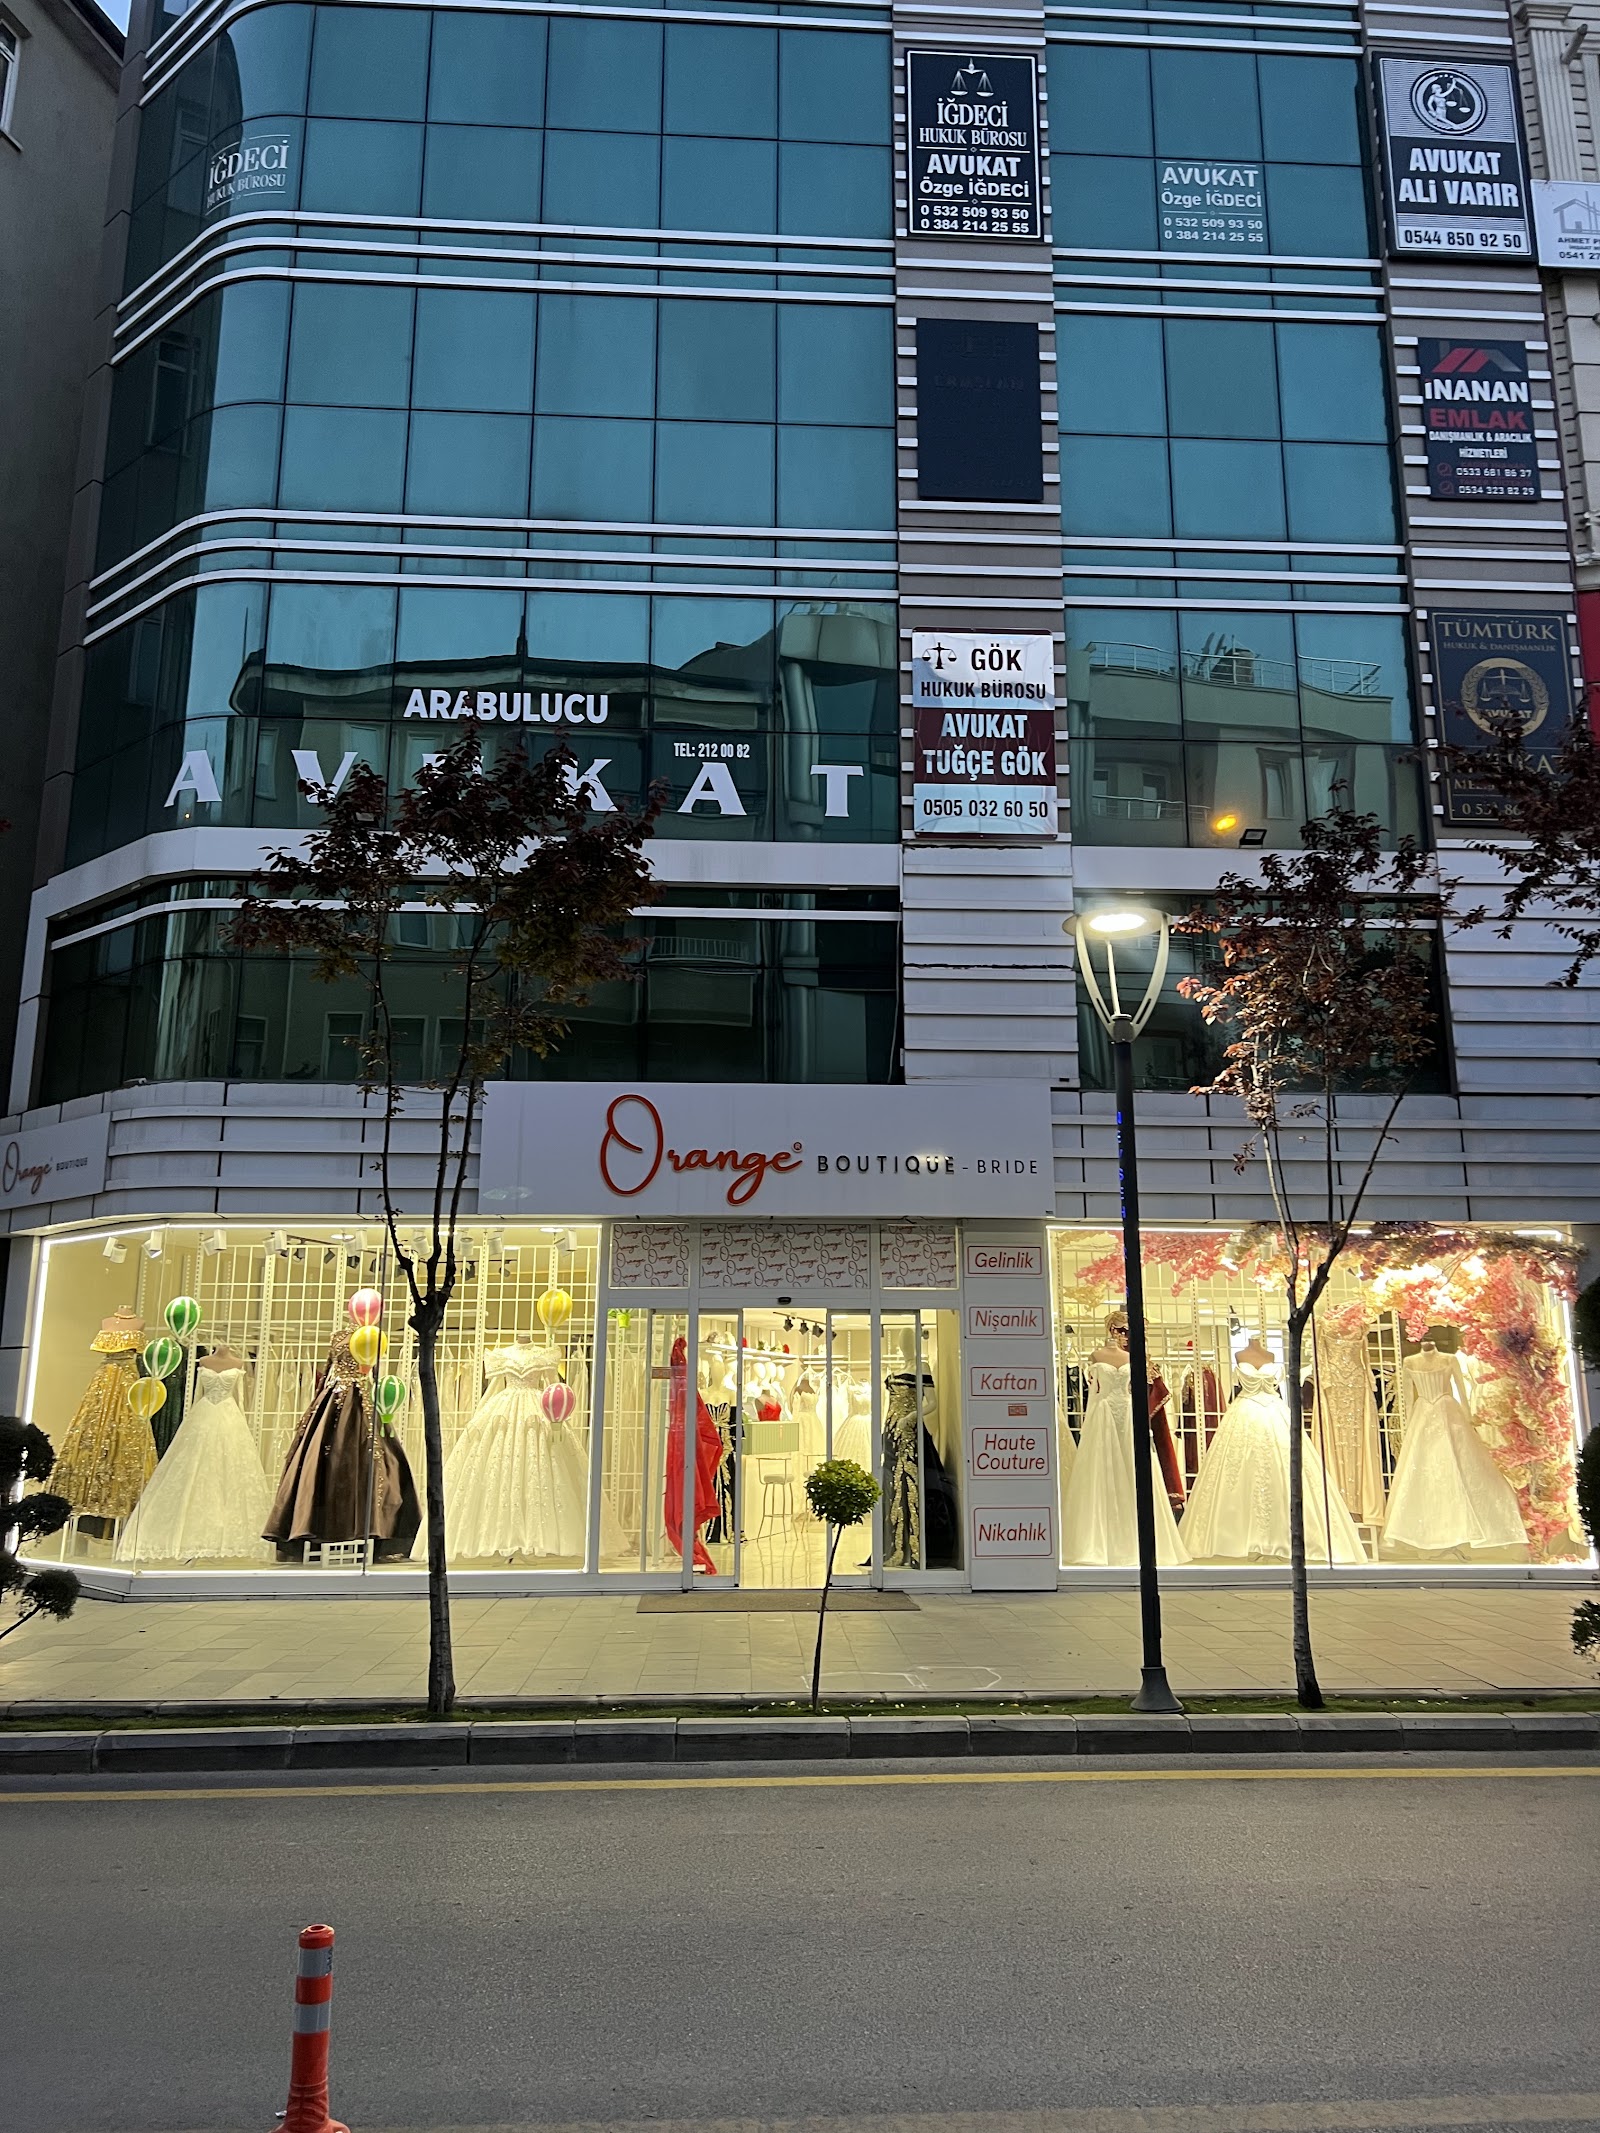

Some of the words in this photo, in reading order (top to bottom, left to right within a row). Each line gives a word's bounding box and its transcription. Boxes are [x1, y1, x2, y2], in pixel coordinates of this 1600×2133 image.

[937, 98, 1008, 127] İĞDECİ
[919, 128, 967, 144] HUKUK
[971, 128, 1027, 147] BÜROSU
[209, 140, 289, 190] İĞDECİ
[927, 154, 1021, 177] AVUKAT
[1409, 148, 1501, 175] AVUKAT
[1162, 166, 1259, 187] AVUKAT
[920, 176, 964, 196] Özge
[968, 178, 1030, 198] İĞDECİ
[1443, 180, 1519, 208] VARIR
[1161, 187, 1201, 208] Özge
[1205, 189, 1262, 207] İĞDECİ
[920, 205, 929, 215] 0
[933, 205, 958, 217] 532
[962, 206, 988, 218] 509
[991, 208, 1008, 219] 93
[1011, 209, 1029, 220] 50
[920, 218, 930, 229] 0
[933, 219, 959, 230] 384
[962, 220, 988, 231] 214
[991, 221, 1008, 232] 25
[1012, 222, 1030, 233] 55
[1163, 217, 1172, 226] 0
[1175, 217, 1198, 227] 532
[1201, 218, 1225, 228] 509
[1228, 219, 1244, 229] 93
[1247, 220, 1263, 229] 50
[1164, 230, 1172, 239] 0
[1176, 230, 1199, 240] 384
[1203, 231, 1226, 240] 214
[1229, 232, 1245, 241] 25
[1248, 233, 1263, 242] 55
[1404, 230, 1441, 245] 0544
[1447, 232, 1475, 246] 850
[1480, 233, 1499, 247] 92
[1504, 234, 1522, 248] 50
[1559, 251, 1585, 259] 0541
[1429, 407, 1528, 430] EMLAK
[1456, 467, 1481, 476] 0533
[1519, 469, 1532, 477] 37
[1458, 485, 1484, 494] 0534
[1486, 486, 1504, 495] 323
[1522, 487, 1535, 495] 29
[1438, 618, 1557, 640] TÜMTÜRK
[971, 643, 1023, 672] GÖK
[920, 681, 976, 698] HUKUK
[981, 680, 1046, 700] BÜROSU
[403, 688, 609, 724] ARABULUCU
[940, 713, 1028, 739] AVUKAT
[673, 742, 696, 758] TEL:
[698, 743, 718, 758] 212
[720, 743, 734, 758] 00
[736, 743, 750, 759] 82
[922, 744, 995, 781] TUĞÇE
[1000, 746, 1048, 776] GÖK
[923, 799, 963, 816] 0505
[969, 800, 998, 817] 032
[1004, 801, 1023, 817] 60
[1029, 801, 1048, 818] 50
[817, 1155, 955, 1174] BOUTIQUE
[977, 1159, 1038, 1174] BRIDE
[974, 1251, 1034, 1269] Gelinlik
[975, 1310, 1038, 1332] Nişanlık
[980, 1372, 1037, 1391] Kaftan
[984, 1433, 1036, 1451] Haute
[976, 1452, 1046, 1470] Couture
[978, 1522, 1047, 1542] Nikahlık
